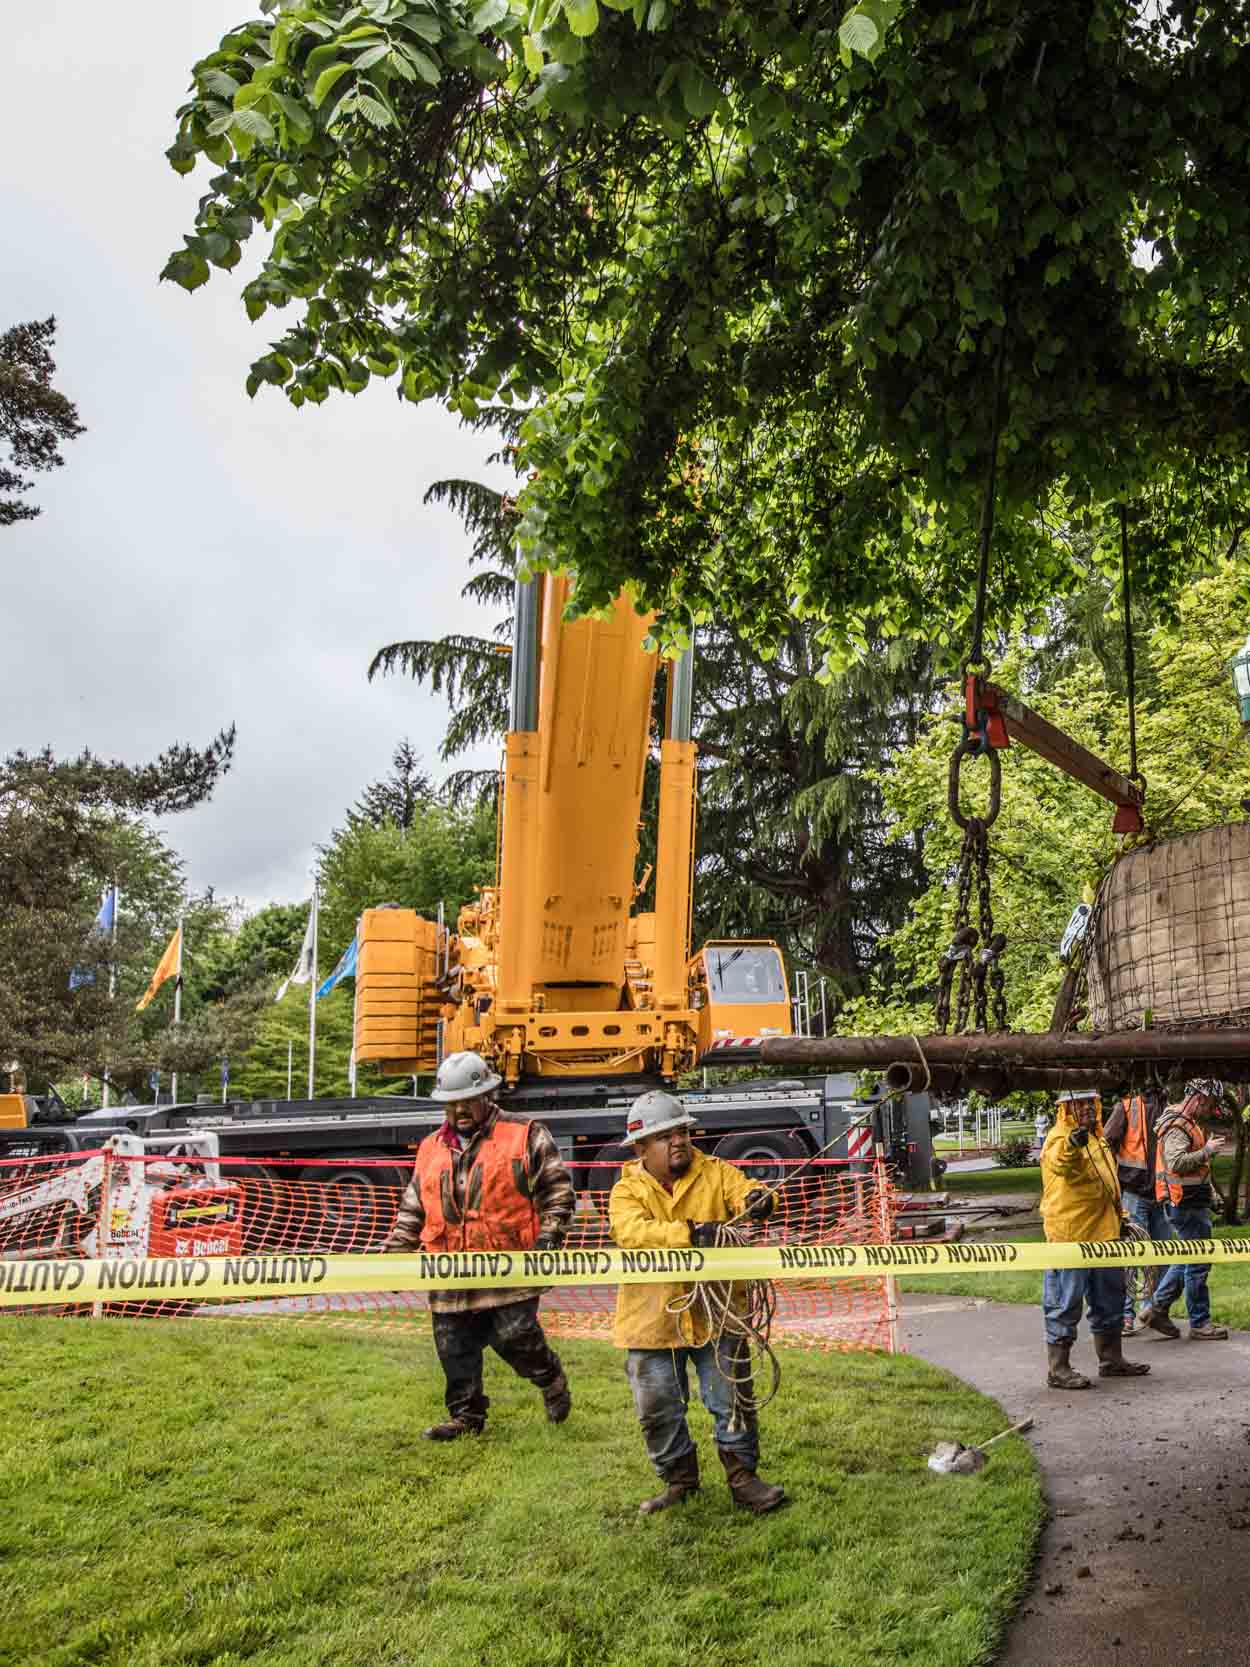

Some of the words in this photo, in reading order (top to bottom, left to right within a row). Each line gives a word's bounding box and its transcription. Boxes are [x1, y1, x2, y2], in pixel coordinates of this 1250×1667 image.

[193, 1238, 229, 1257] Bobcat
[779, 1246, 857, 1268] CAUTION
[863, 1245, 939, 1266] CAUTION
[943, 1243, 1017, 1262] CAUTION
[1078, 1241, 1145, 1259] CAUTION
[1151, 1239, 1215, 1256] CAUTION
[223, 1256, 327, 1285] CAUTION
[420, 1253, 512, 1279] CAUTION
[524, 1251, 610, 1276] CAUTION
[622, 1250, 704, 1273] CAUTION
[97, 1260, 209, 1289] CAUTION
